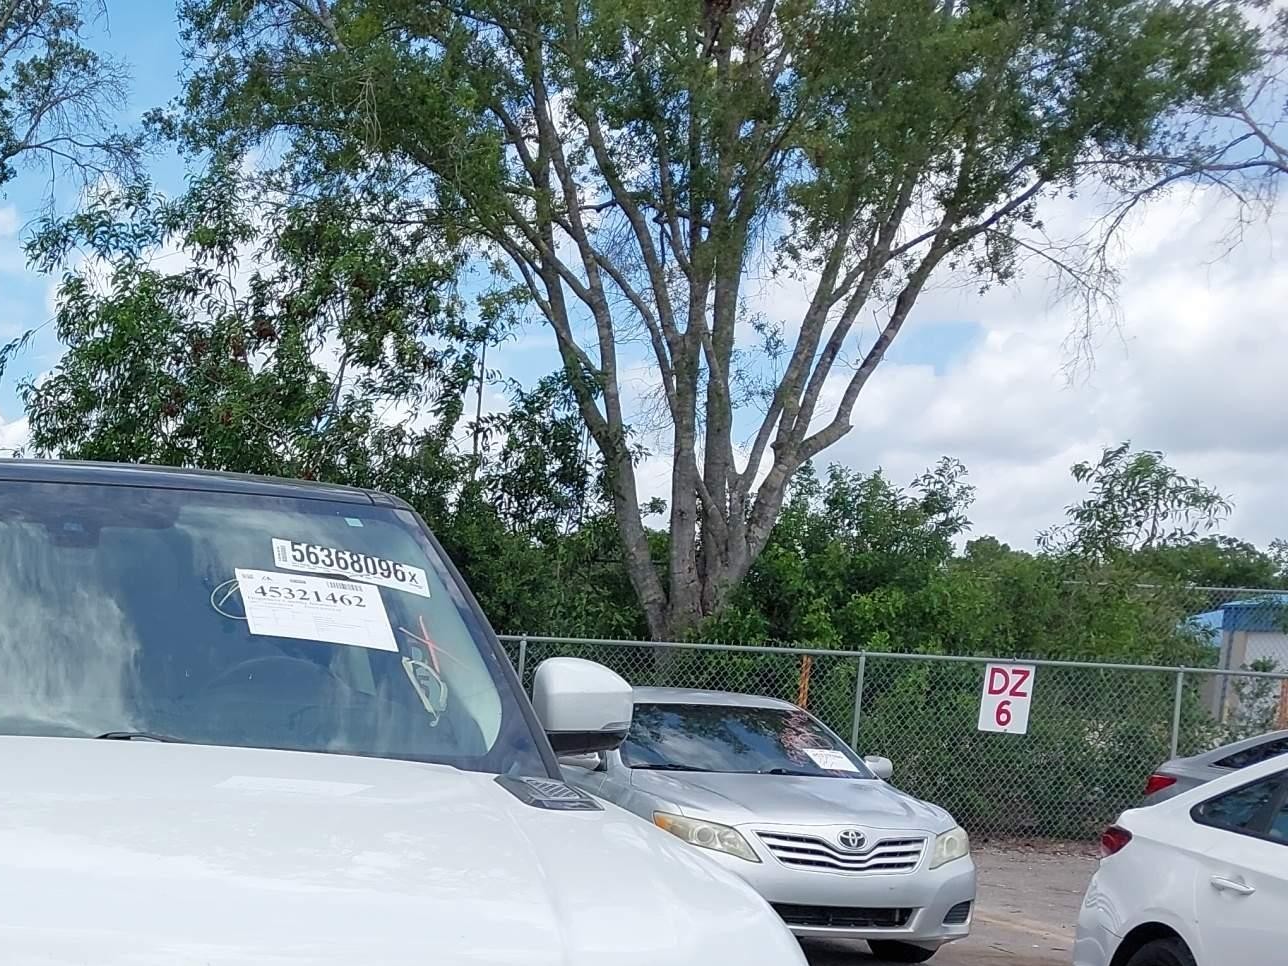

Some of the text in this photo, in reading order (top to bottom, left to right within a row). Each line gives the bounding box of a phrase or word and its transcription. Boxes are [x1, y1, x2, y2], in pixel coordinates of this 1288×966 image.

[290, 541, 406, 582] 56368096
[253, 584, 367, 608] 45321462
[987, 667, 1030, 698] DZ
[995, 699, 1012, 727] 6
